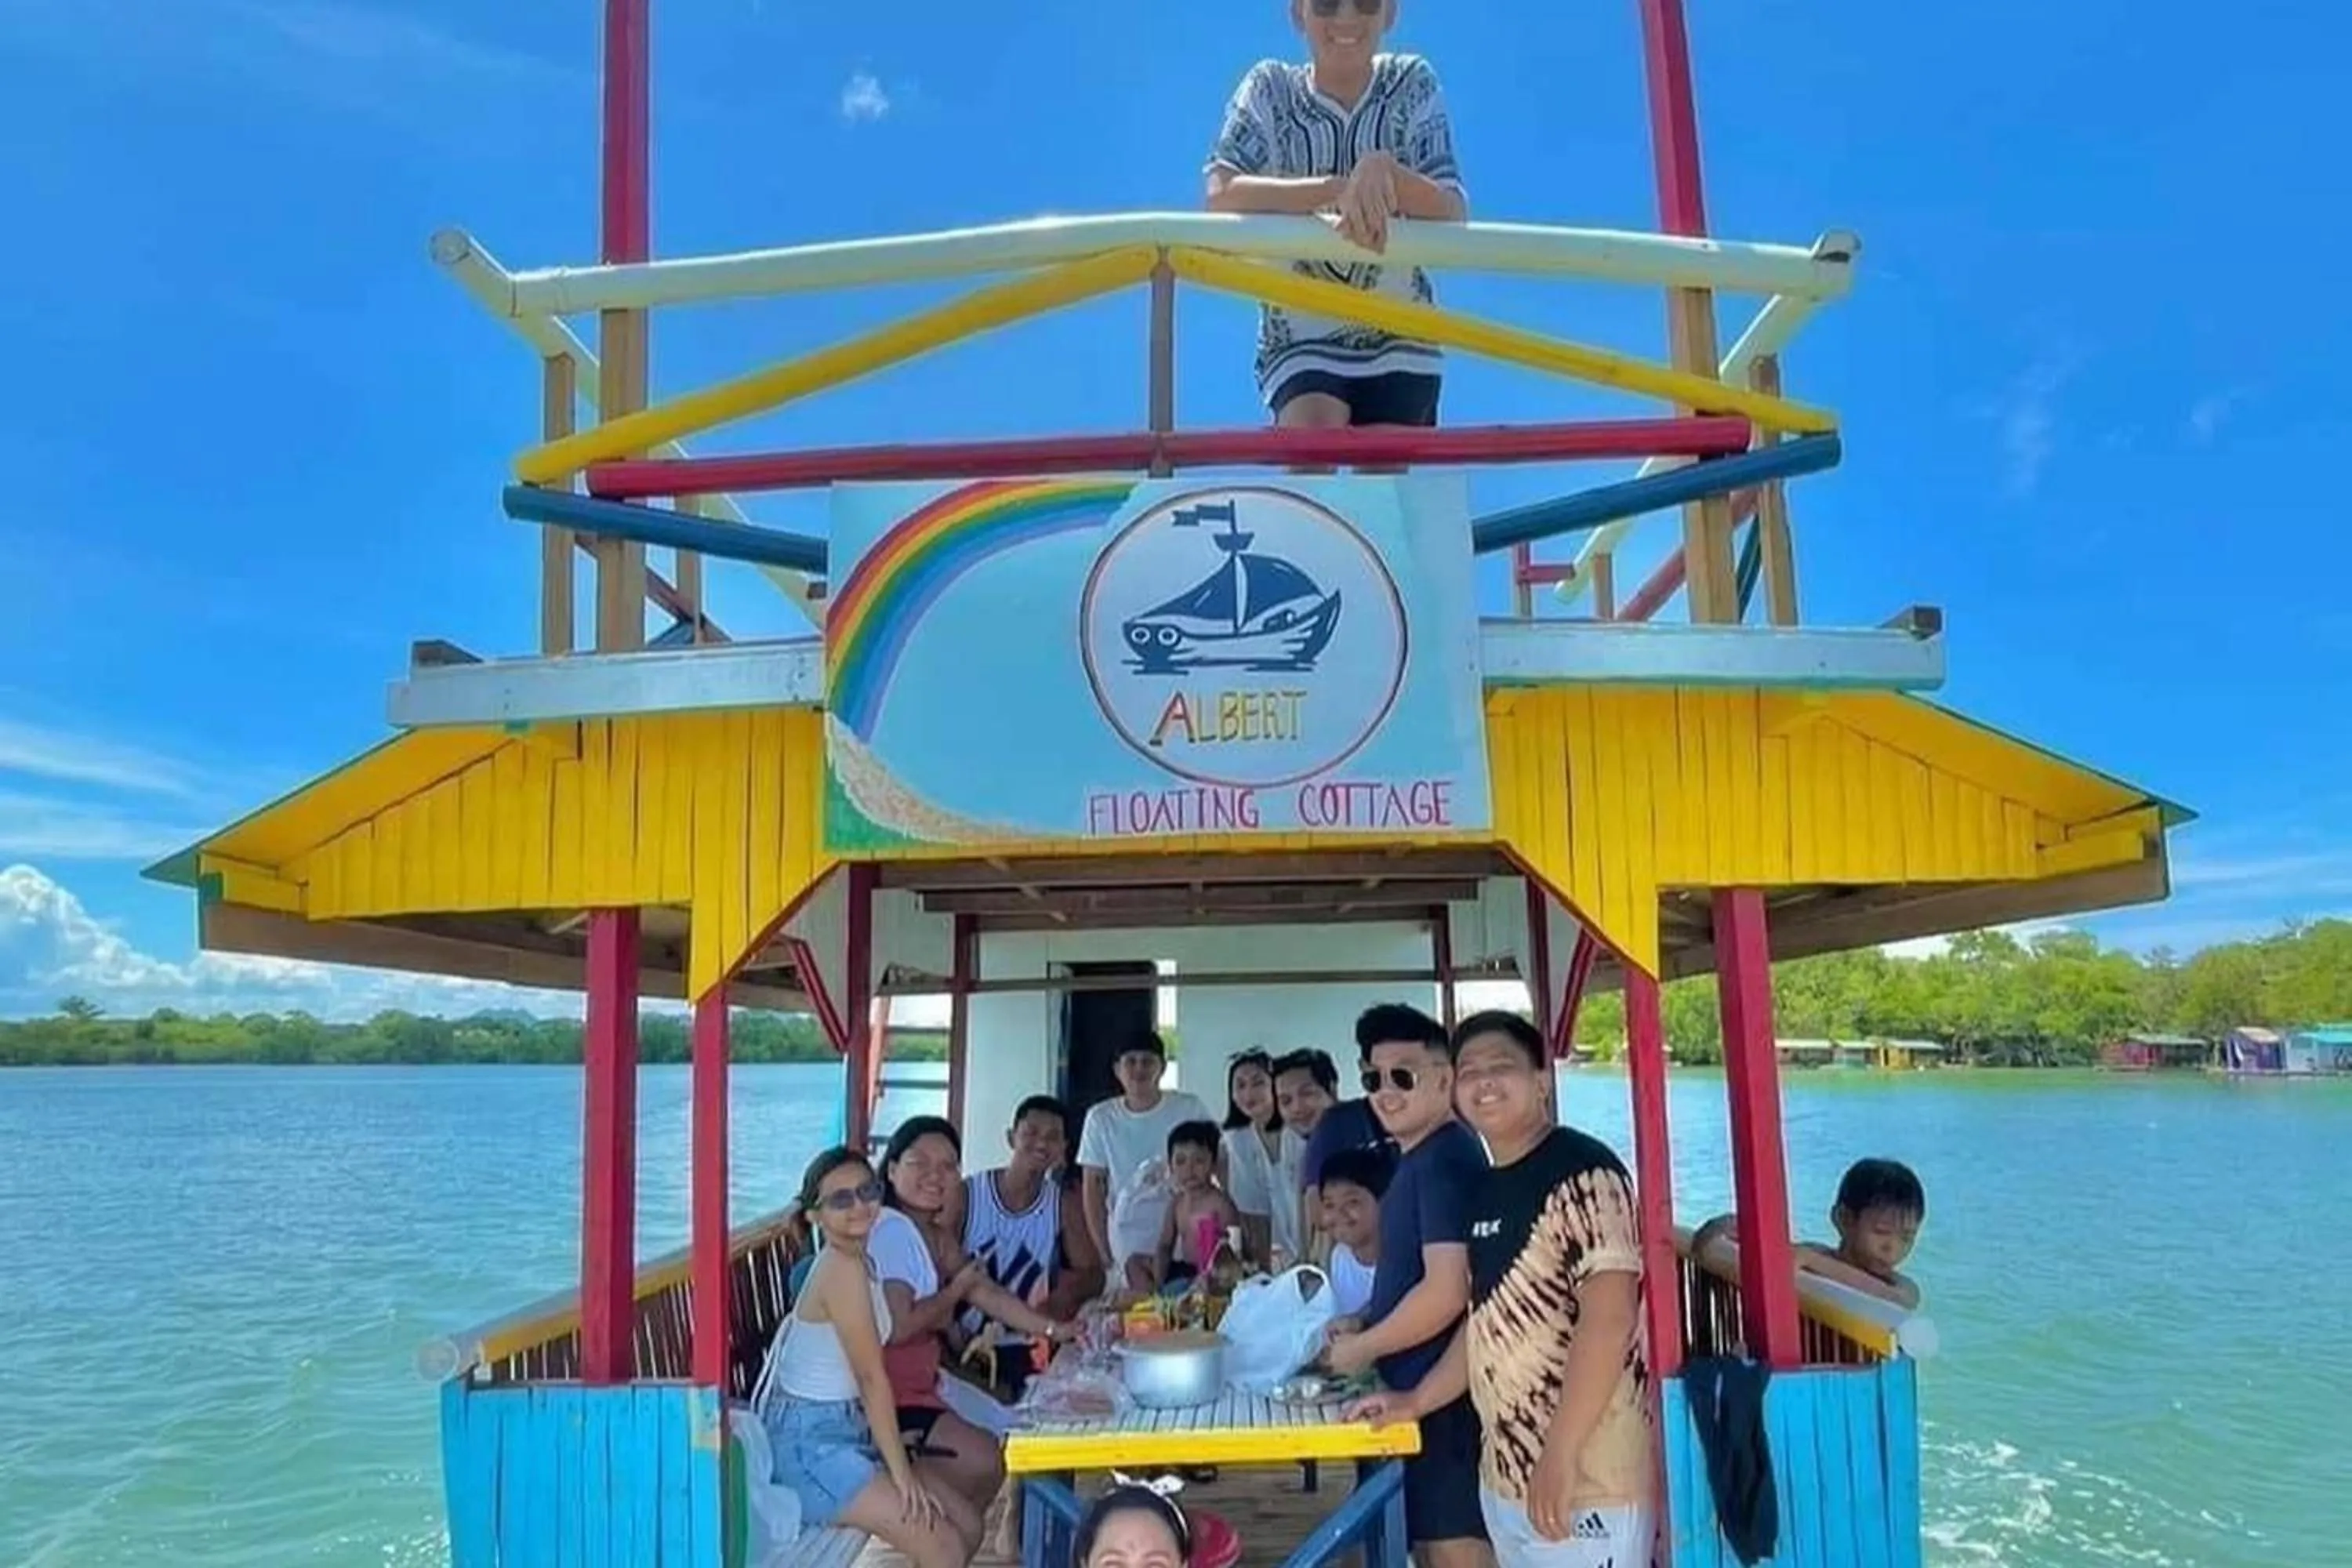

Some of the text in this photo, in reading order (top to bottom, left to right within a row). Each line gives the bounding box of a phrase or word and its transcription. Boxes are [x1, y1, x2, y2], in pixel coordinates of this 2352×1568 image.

[1149, 691, 1308, 746] ALBERT
[1089, 781, 1453, 836] FLOATING COTTAGE
